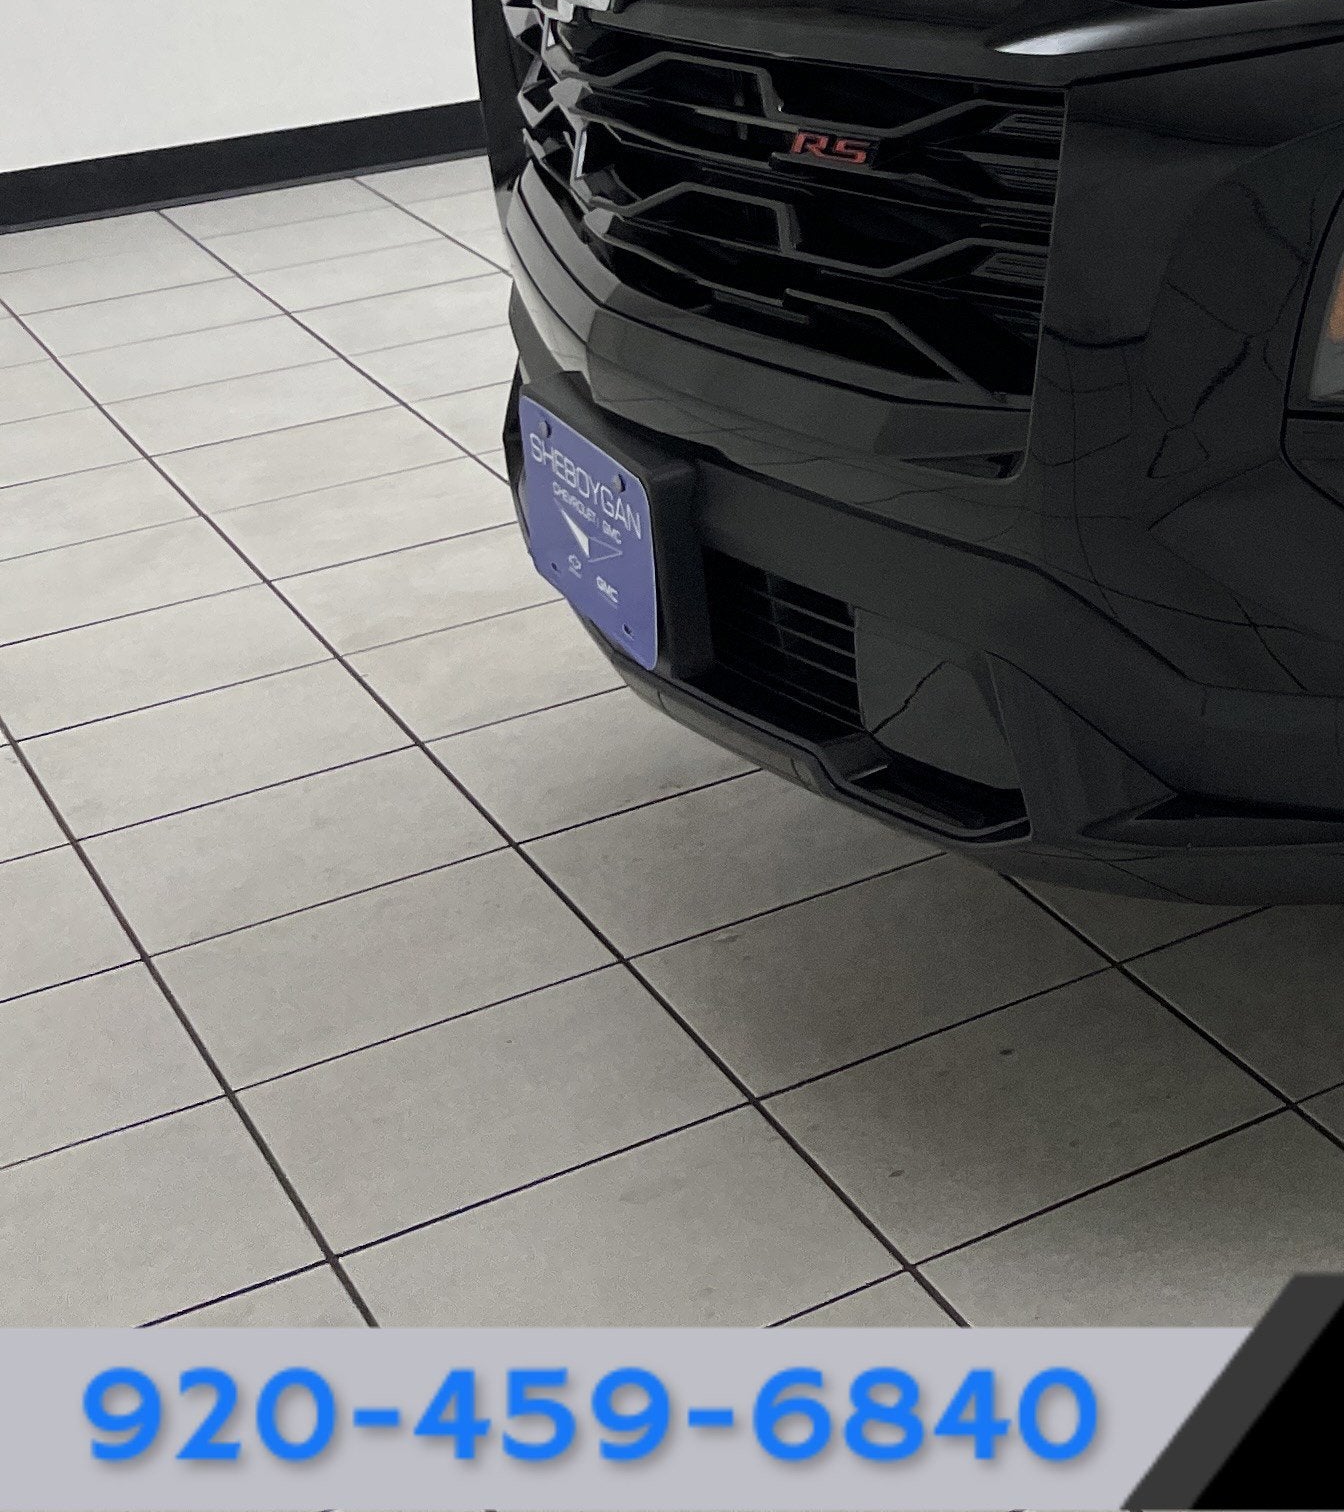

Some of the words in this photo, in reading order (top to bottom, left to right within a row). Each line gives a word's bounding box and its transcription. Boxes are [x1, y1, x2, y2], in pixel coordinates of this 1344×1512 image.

[789, 131, 871, 164] RS
[529, 432, 642, 540] SHEBOYGAN
[596, 575, 618, 604] GMC
